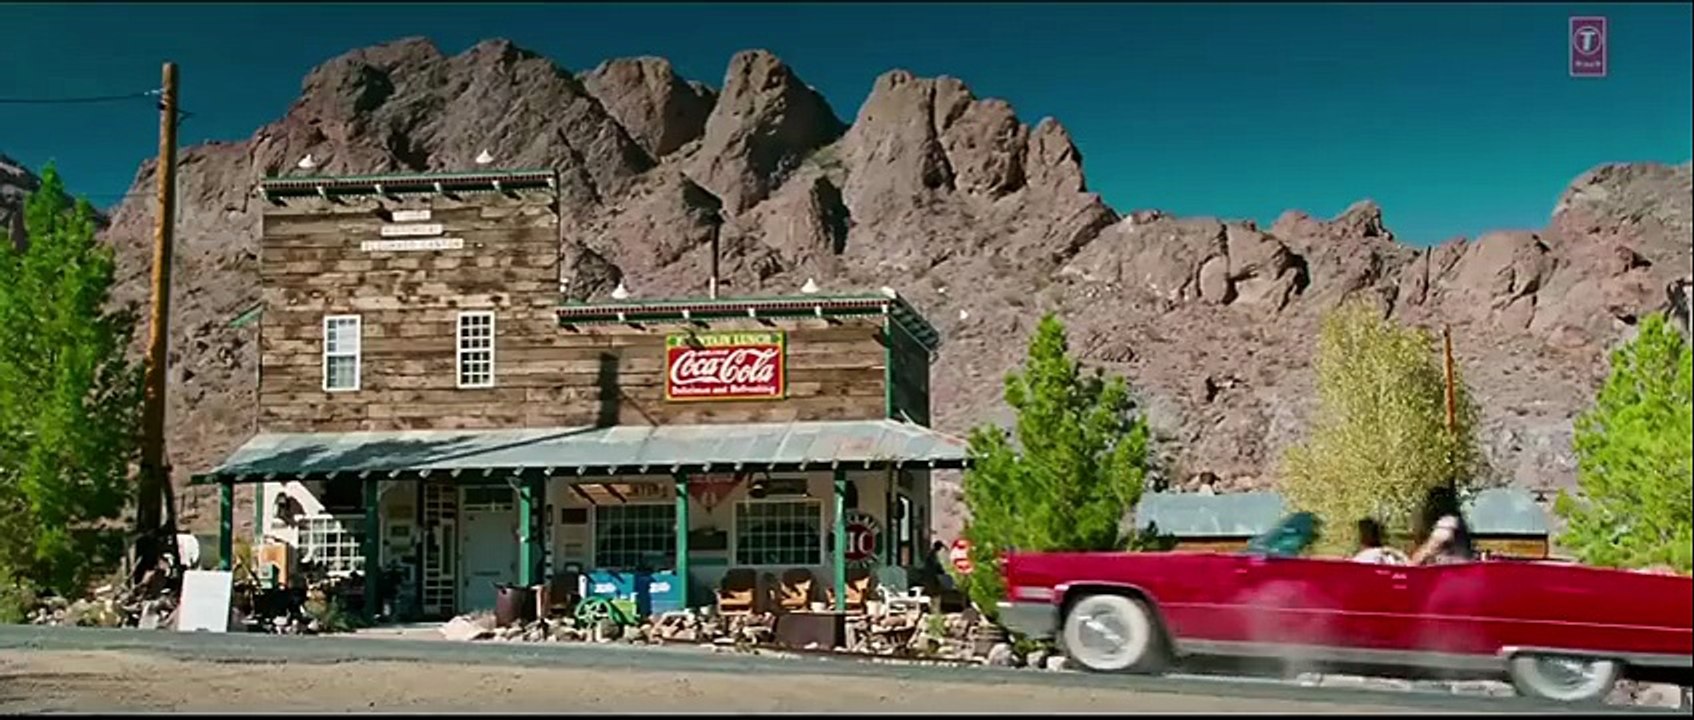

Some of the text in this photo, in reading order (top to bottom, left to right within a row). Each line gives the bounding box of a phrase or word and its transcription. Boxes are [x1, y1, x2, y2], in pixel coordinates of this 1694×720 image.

[677, 332, 771, 347] FNTAIN LUNCH
[670, 348, 780, 385] Coca-Cola
[713, 386, 728, 394] and
